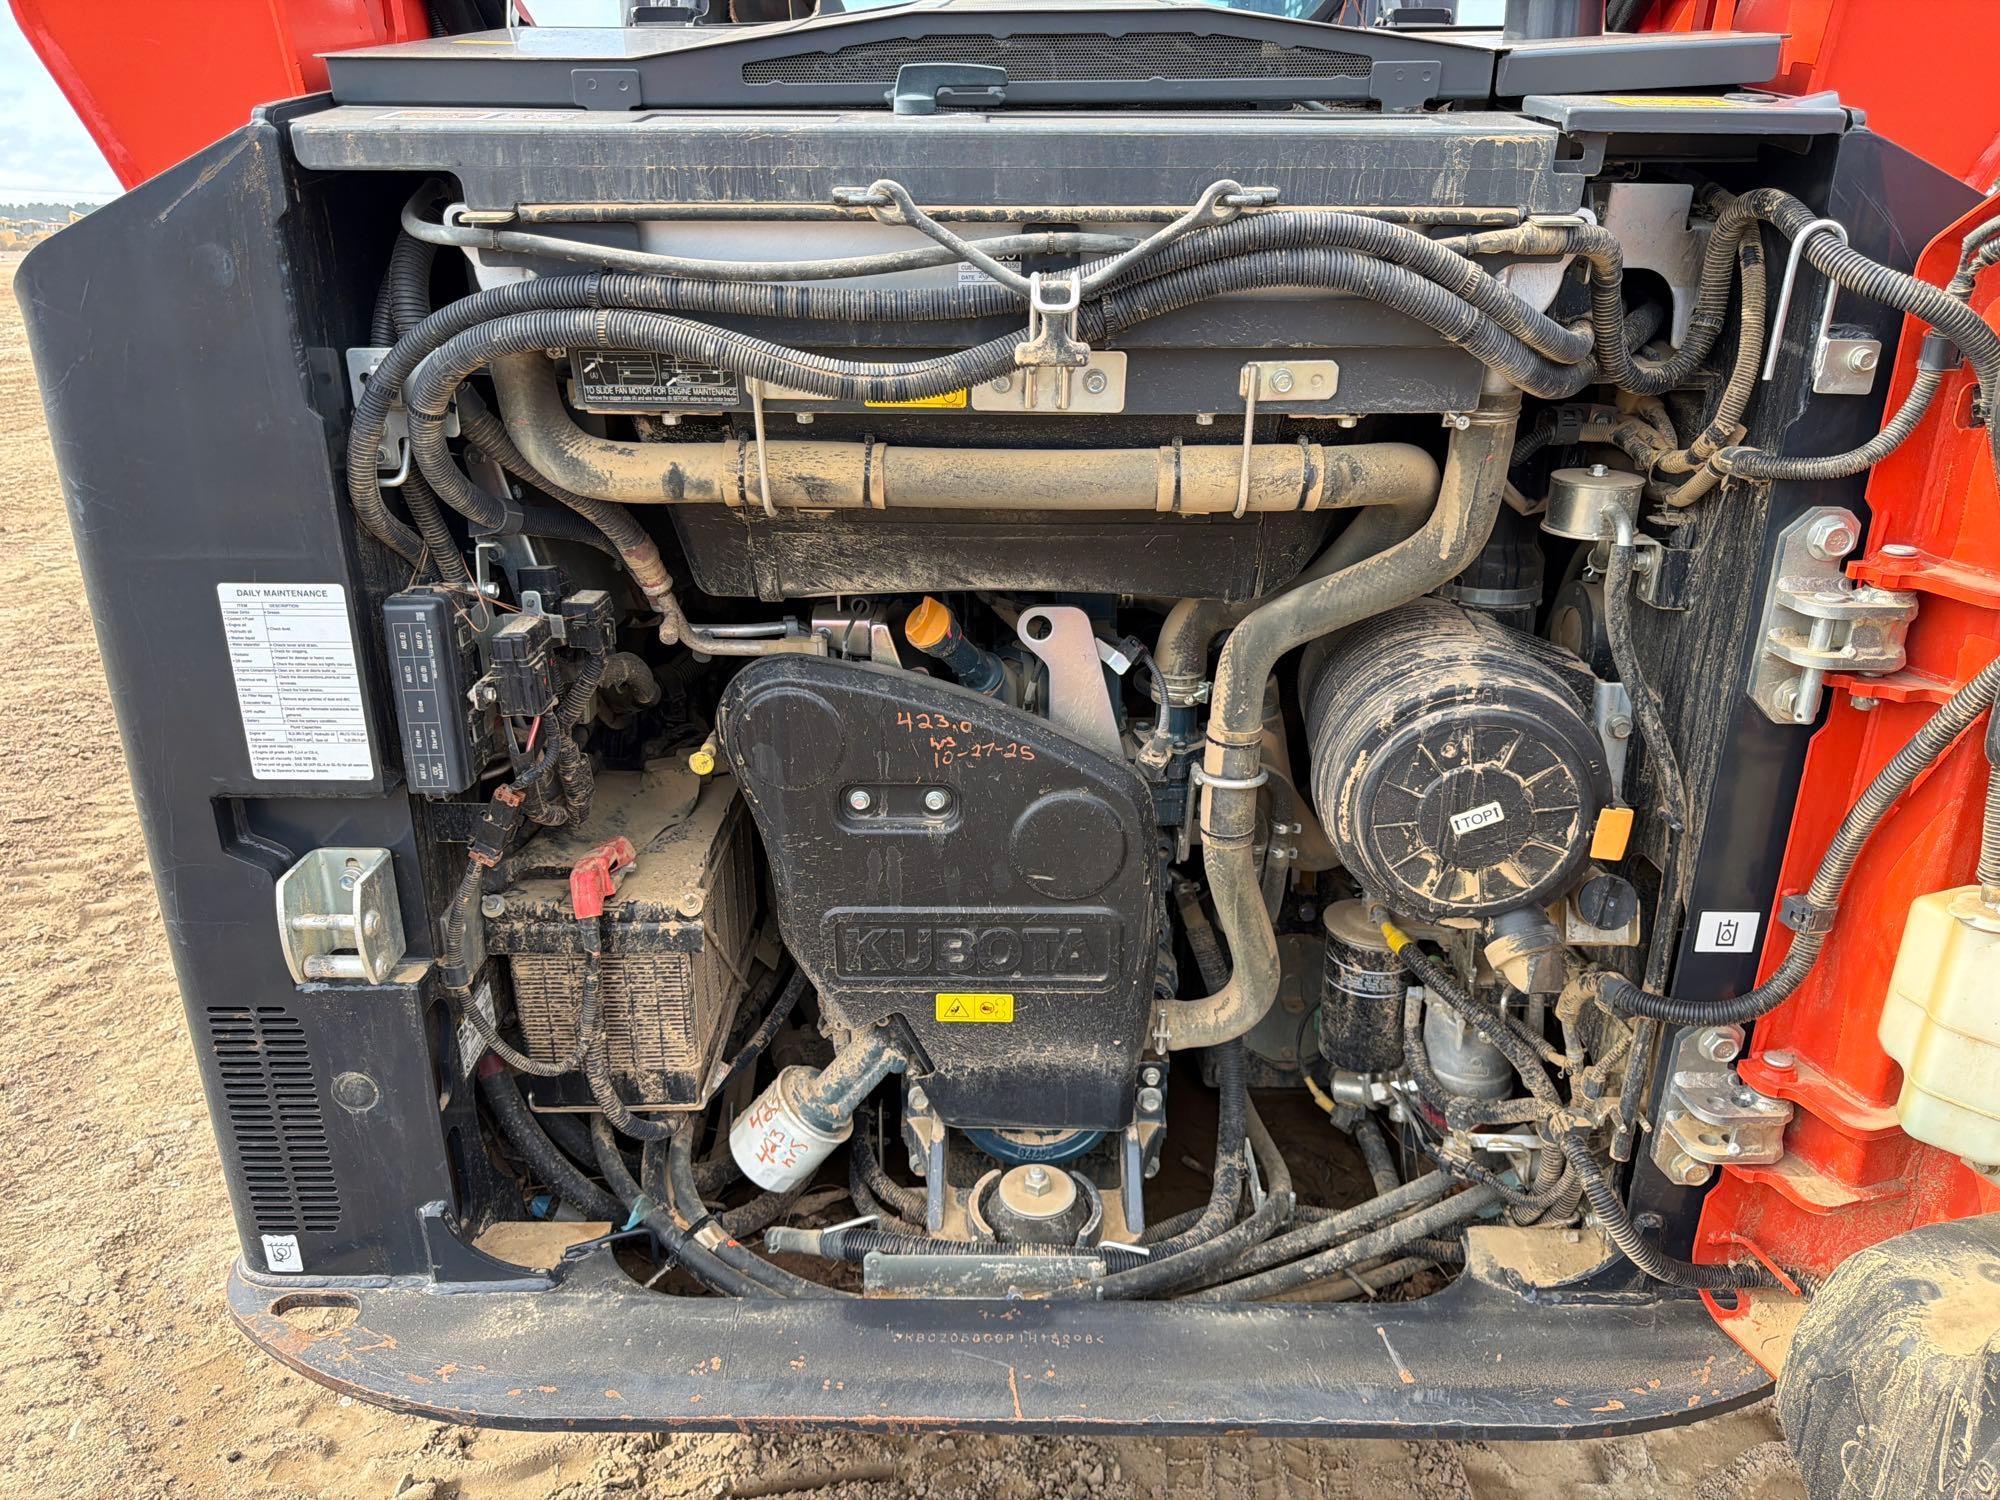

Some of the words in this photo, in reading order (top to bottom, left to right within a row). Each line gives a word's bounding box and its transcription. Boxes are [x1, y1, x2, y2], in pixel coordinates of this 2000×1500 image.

[586, 387, 595, 395] TO
[596, 387, 614, 396] SLIDE
[615, 387, 628, 396] FAN
[628, 387, 651, 396] MOTOR
[653, 388, 667, 396] FOR
[668, 388, 692, 396] ENGINE
[692, 388, 737, 396] MAINTENANCE
[236, 589, 260, 597] DAILY
[264, 590, 328, 598] MAINTENANCE
[897, 711, 972, 734] 423.0
[430, 728, 438, 750] Starter
[934, 742, 1036, 769] 10-27-25
[1461, 810, 1492, 828] TOP
[845, 927, 1098, 972] KUBOTA
